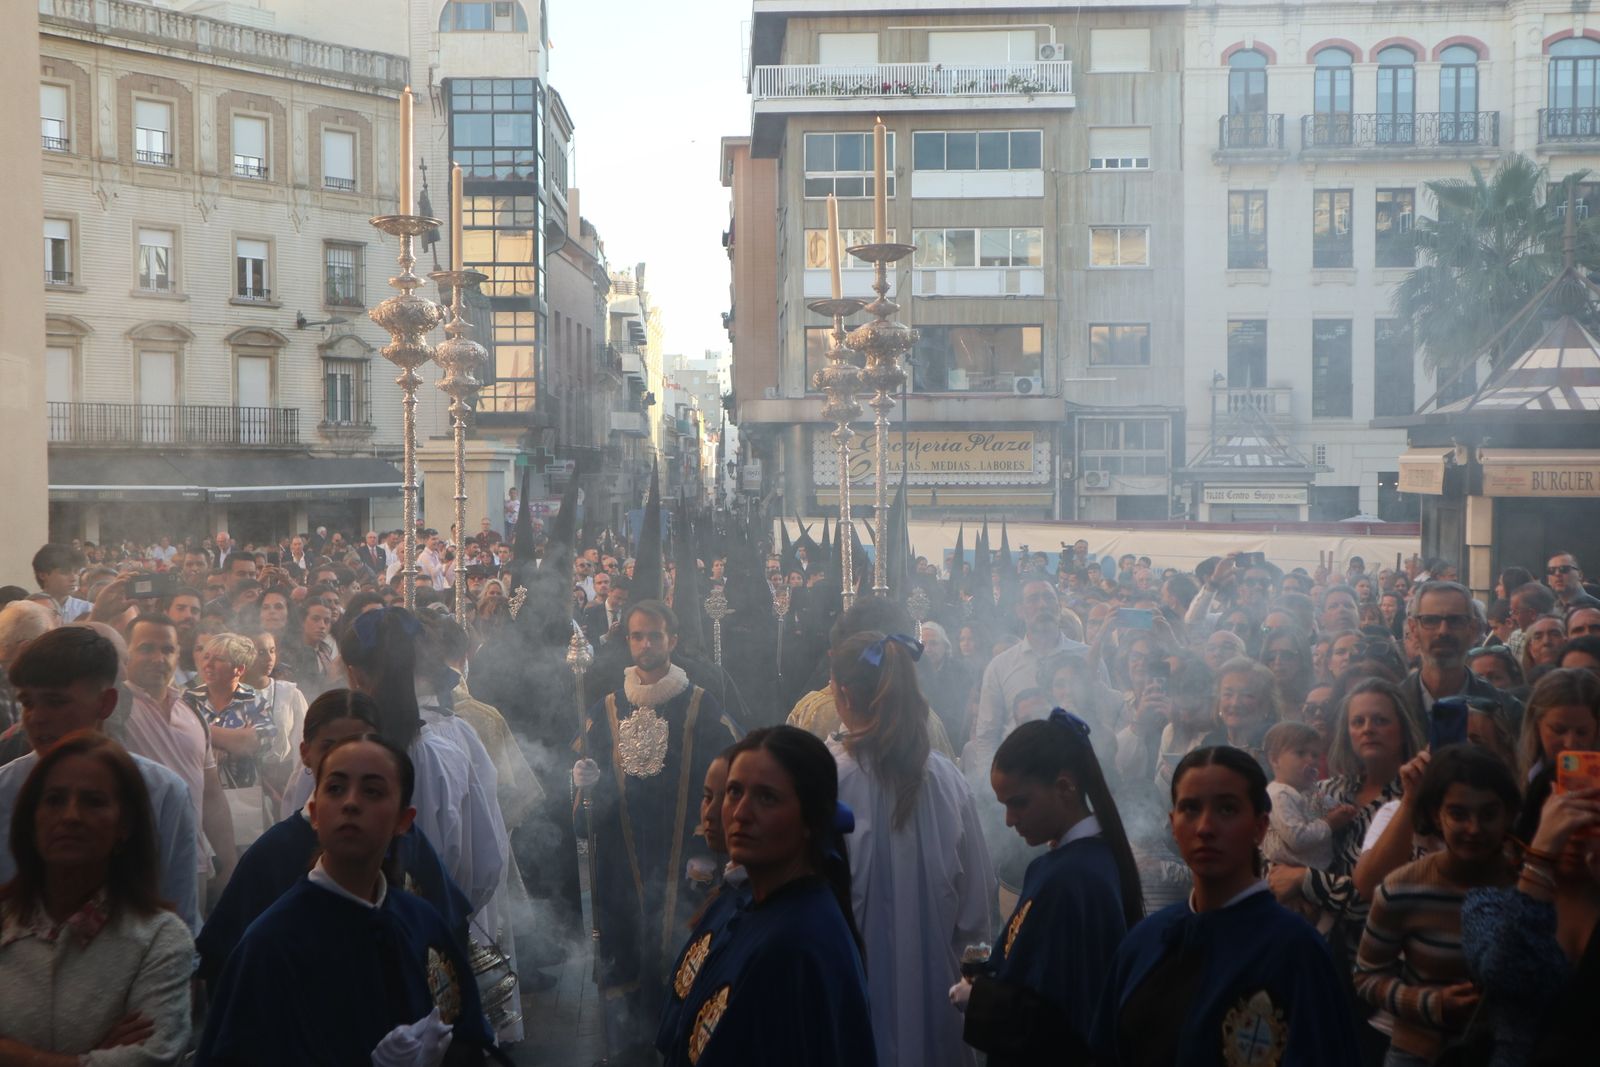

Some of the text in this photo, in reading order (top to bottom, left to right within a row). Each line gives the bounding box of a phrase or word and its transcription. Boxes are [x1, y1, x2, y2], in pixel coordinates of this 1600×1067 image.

[847, 433, 1032, 478] Ecajeria Plaza
[888, 460, 1025, 471] LAAS MEDIAS LABORES
[1532, 471, 1594, 491] BURGUER
